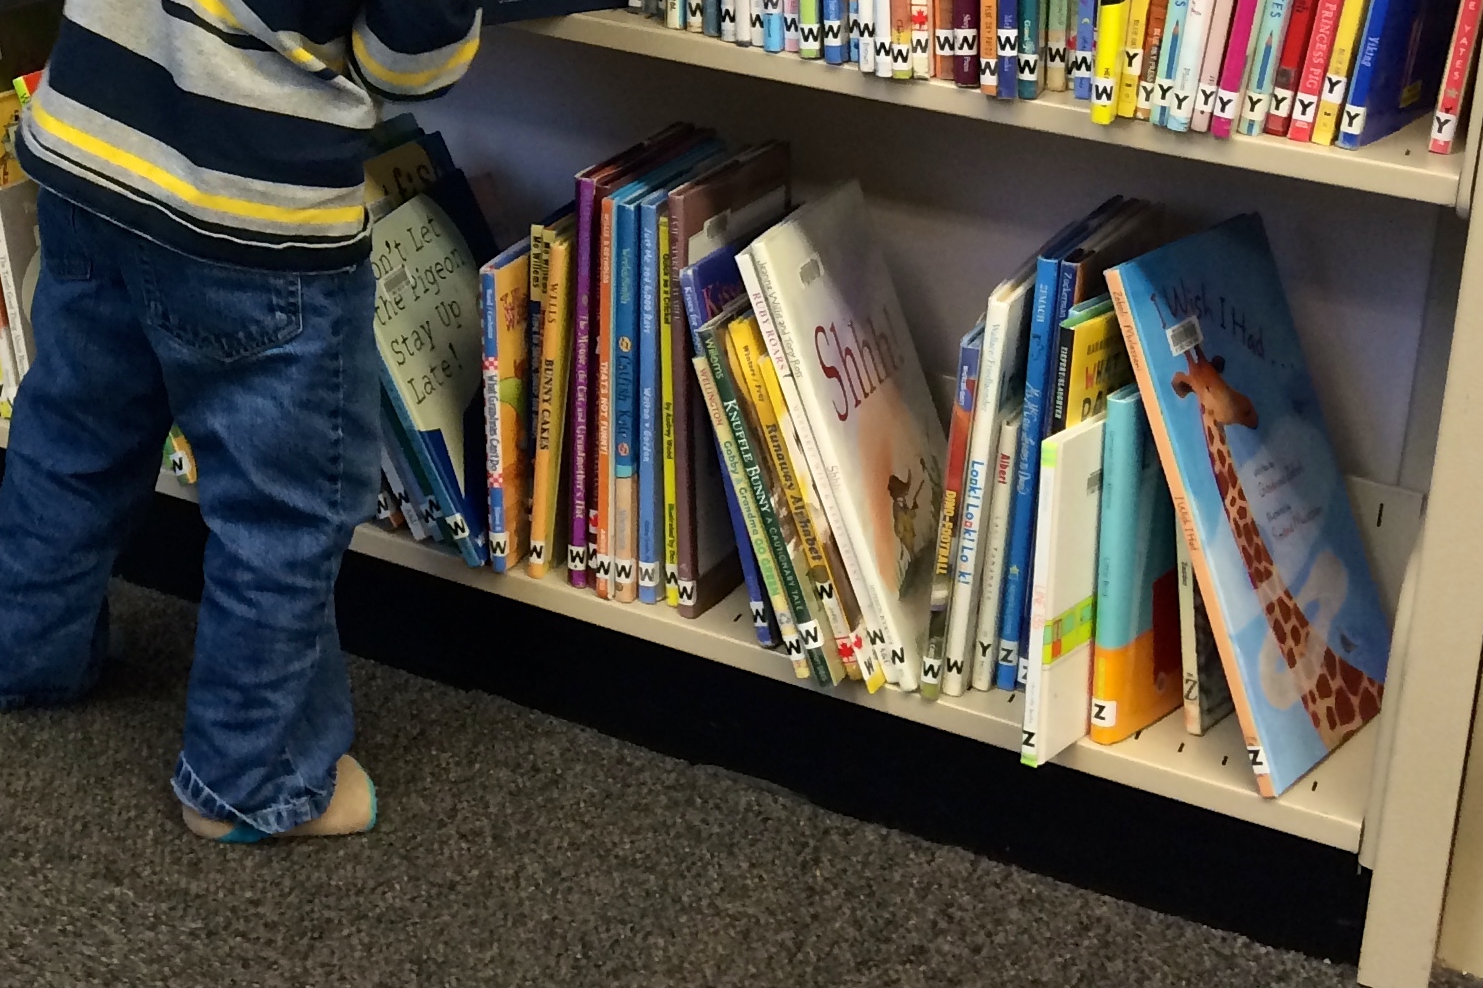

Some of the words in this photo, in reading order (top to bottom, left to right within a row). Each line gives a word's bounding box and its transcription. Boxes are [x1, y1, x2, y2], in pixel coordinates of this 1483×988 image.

[800, 28, 820, 44] W
[957, 34, 977, 50] W
[1310, 6, 1339, 64] PRINCESS
[1363, 36, 1380, 67] Viking
[1452, 24, 1472, 81] YATES
[1094, 85, 1114, 103] W
[1305, 68, 1323, 89] PIG
[1175, 92, 1190, 111] Y
[1218, 97, 1235, 114] Y
[1248, 95, 1263, 113] Y
[1435, 116, 1451, 134] Y
[373, 234, 406, 280] on't
[406, 214, 442, 250] Let
[532, 235, 542, 251] Mo
[408, 242, 468, 300] Pigeon
[532, 253, 542, 288] Willems
[547, 282, 559, 324] WILLS
[390, 324, 432, 367] Stay
[433, 297, 463, 336] Up
[752, 293, 770, 326] RUBY
[764, 329, 787, 372] ROARS
[407, 341, 464, 406] Late!
[542, 359, 554, 405] BUNNY
[601, 361, 609, 396] THAT'S
[601, 398, 609, 418] NOT
[698, 367, 724, 426] WELLINGTON
[540, 409, 553, 450] CAKES
[600, 420, 609, 455] FUNNY!
[997, 453, 1011, 485] Albert
[723, 399, 757, 463] KNUFFLE
[744, 465, 771, 513] BUNNY
[768, 527, 796, 588] CAUTIONARY
[789, 589, 804, 611] TALE
[765, 423, 795, 491] Runaway
[789, 494, 821, 562] Alphabet
[935, 490, 958, 575] DINO-FOOTBALL
[946, 657, 964, 674] W
[1000, 647, 1014, 663] Z
[1093, 704, 1107, 720] Z
[1248, 749, 1264, 767] Z
